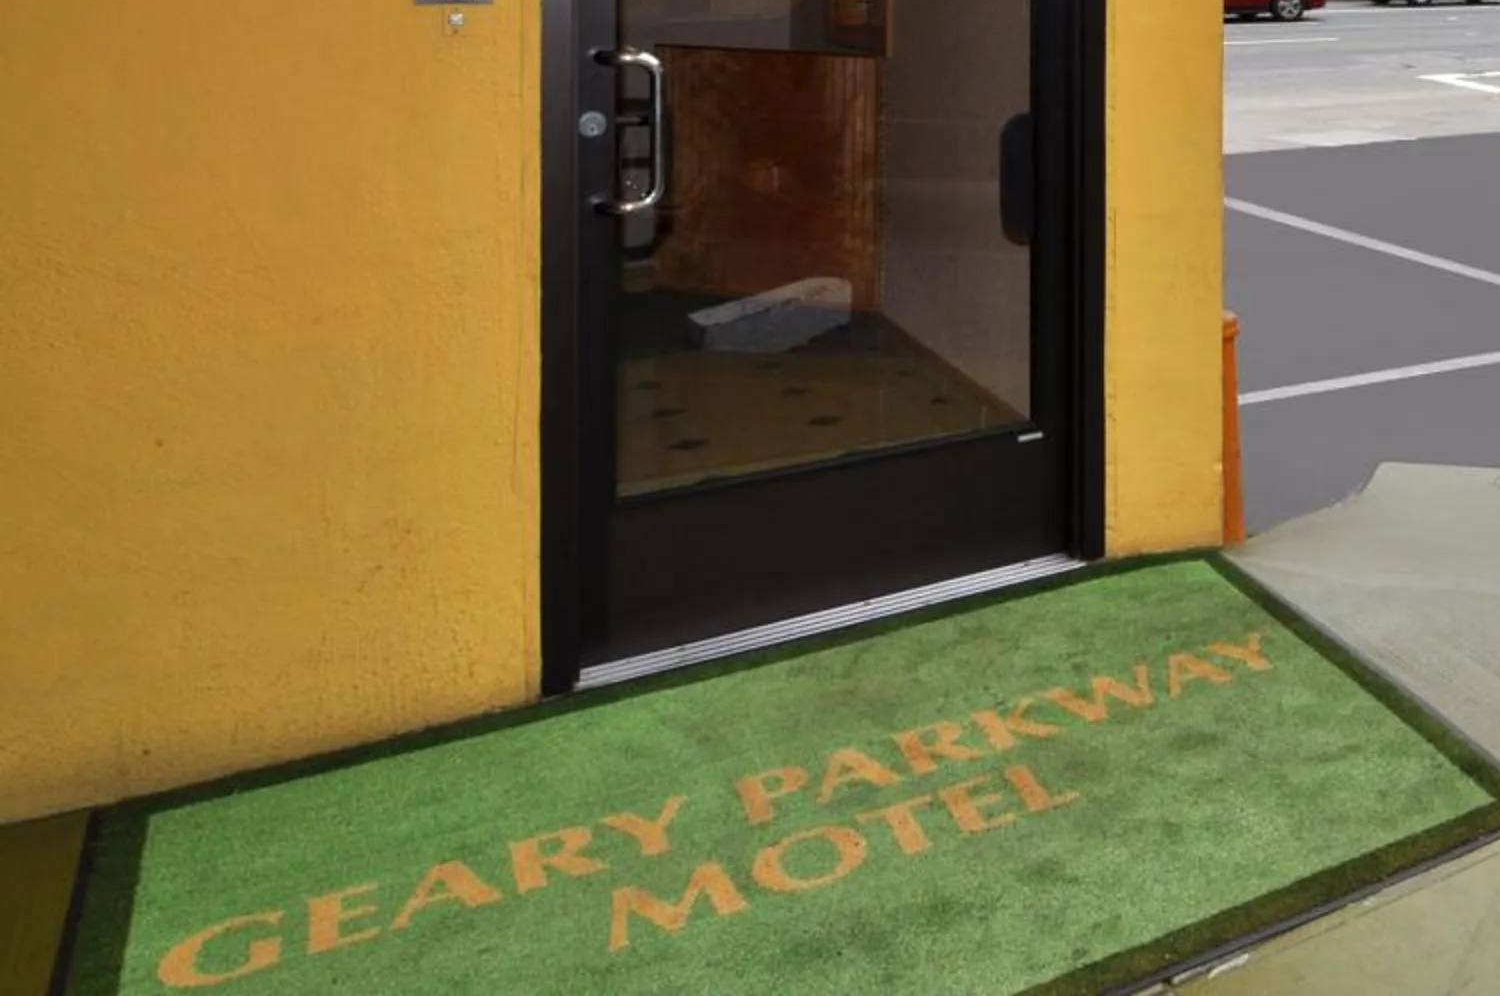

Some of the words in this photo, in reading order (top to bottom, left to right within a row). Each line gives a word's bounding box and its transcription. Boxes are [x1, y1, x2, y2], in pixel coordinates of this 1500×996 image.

[158, 795, 686, 987] GEARY
[734, 632, 1272, 825] PARKWAY
[608, 765, 1080, 951] MOTEL
